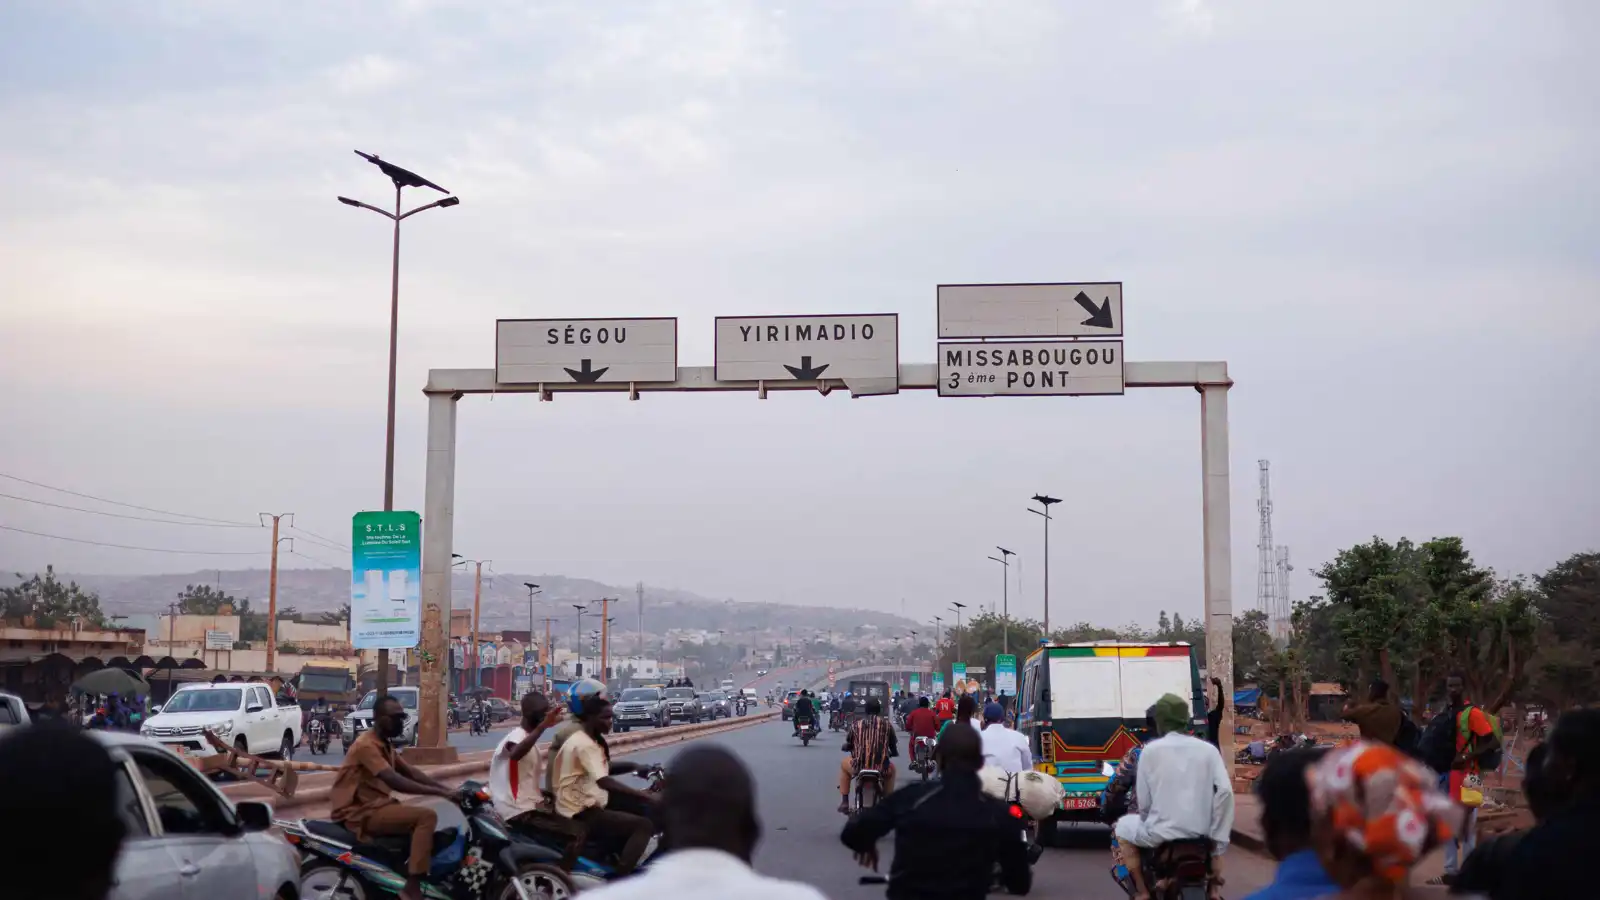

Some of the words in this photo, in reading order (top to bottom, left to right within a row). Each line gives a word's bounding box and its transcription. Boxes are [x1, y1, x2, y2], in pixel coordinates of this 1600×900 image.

[547, 324, 626, 344] SÉGOU
[740, 323, 874, 342] YIRIMADIO
[946, 348, 1115, 367] MISSABOUGOU
[1007, 371, 1069, 388] PONT
